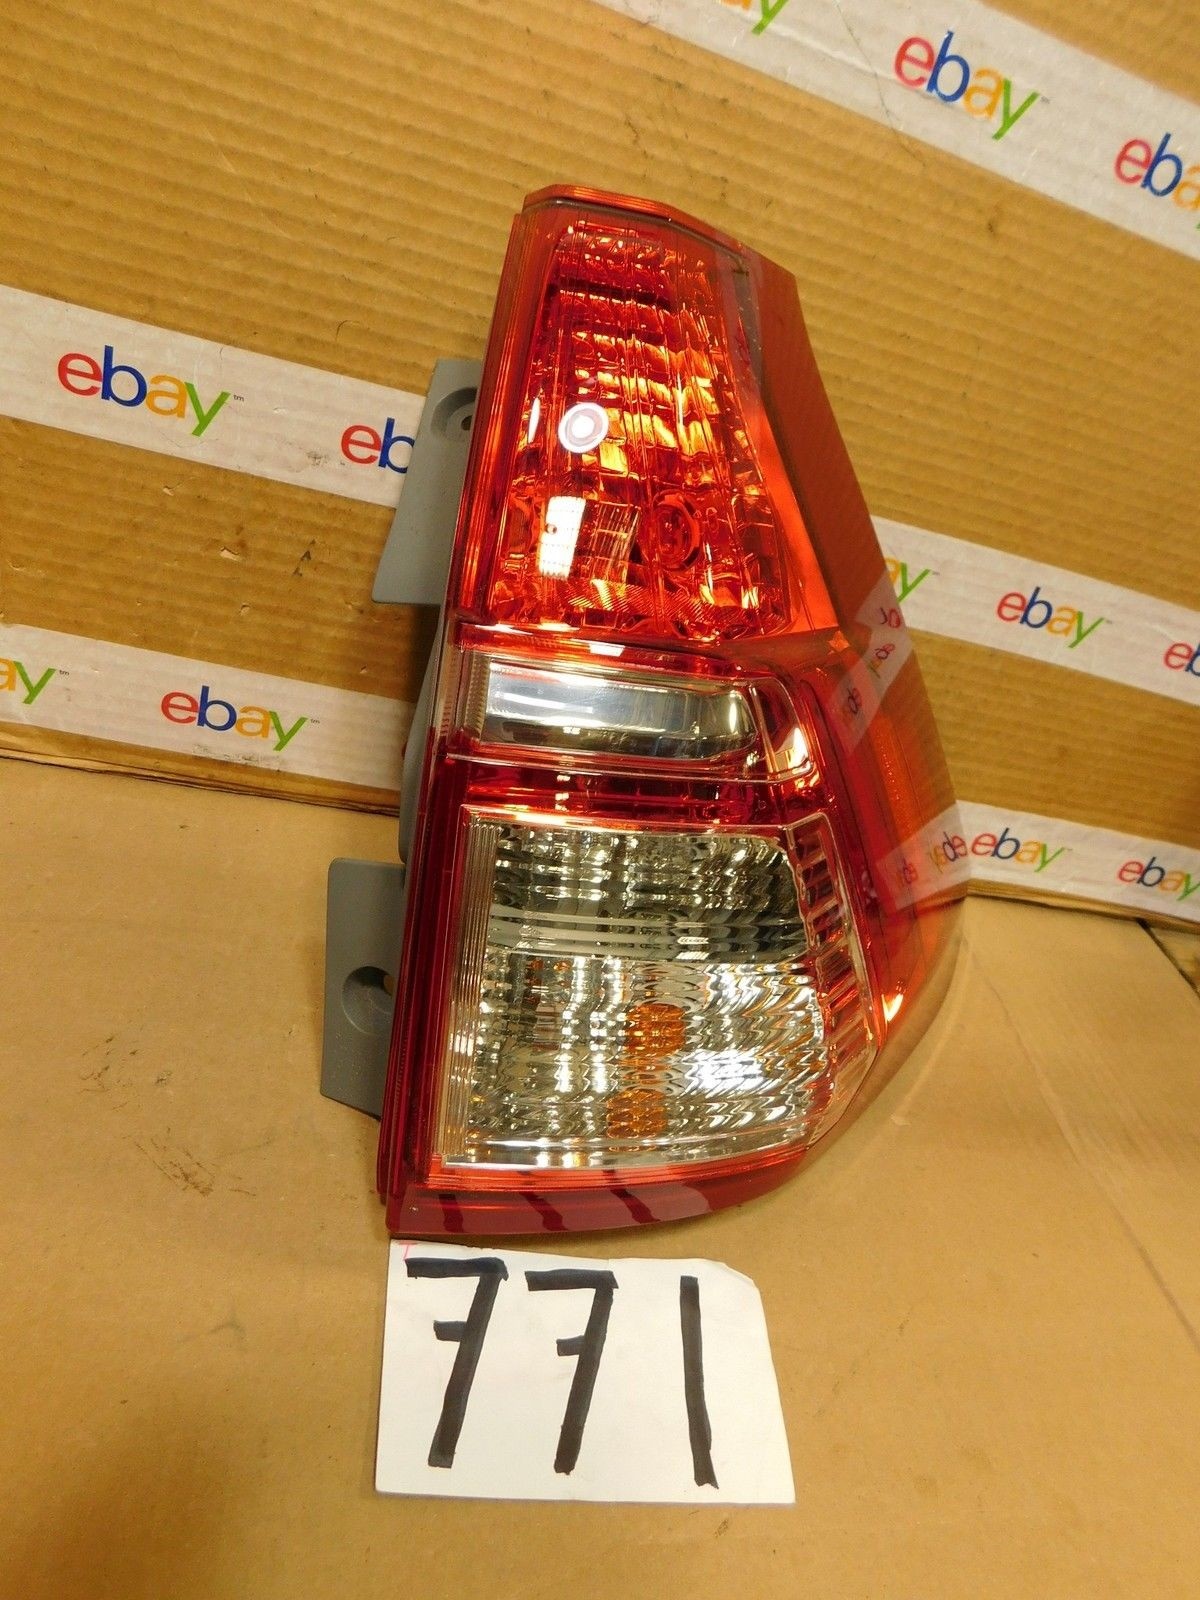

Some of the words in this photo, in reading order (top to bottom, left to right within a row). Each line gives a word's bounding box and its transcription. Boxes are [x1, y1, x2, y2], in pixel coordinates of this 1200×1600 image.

[894, 31, 1040, 141] ebay
[1115, 132, 1200, 230] eba
[57, 345, 231, 437] ebay
[340, 417, 415, 474] eb
[996, 586, 1104, 649] ebay
[160, 685, 308, 752] ebay
[971, 827, 1064, 874] ebay
[405, 1256, 720, 1490] 771
